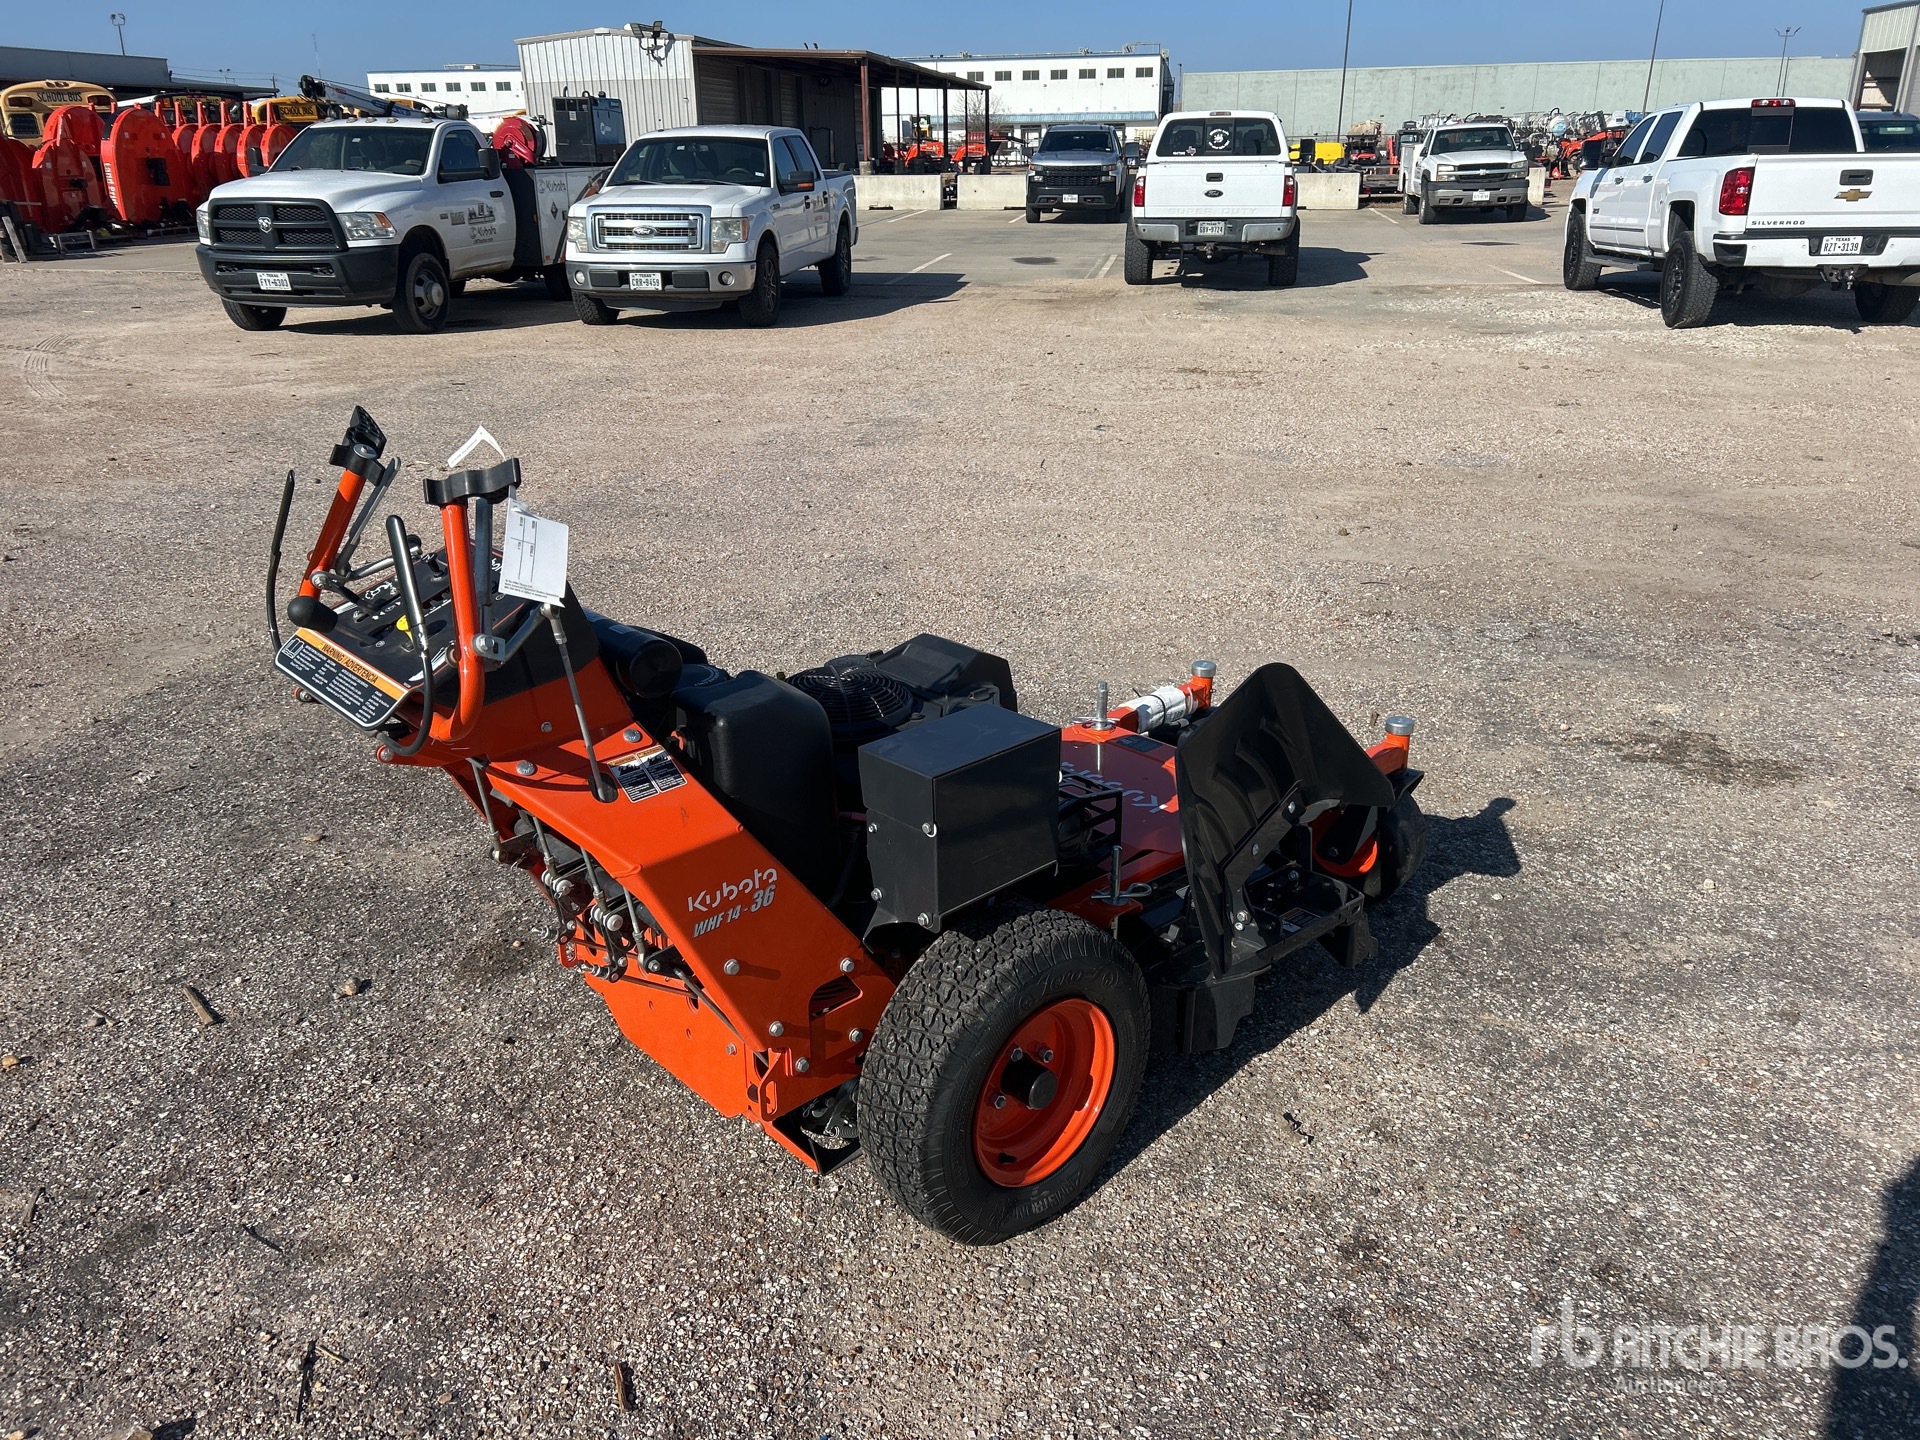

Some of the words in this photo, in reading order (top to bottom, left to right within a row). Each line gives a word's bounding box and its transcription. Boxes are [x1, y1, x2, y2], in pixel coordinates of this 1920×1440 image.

[37, 91, 66, 102] SCHOOL
[68, 92, 82, 102] BUS
[280, 106, 301, 116] SCHOOL
[302, 107, 314, 116] BUS
[103, 163, 115, 185] Land
[1168, 207, 1213, 216] SUPER
[1221, 207, 1258, 216] DUTY
[321, 643, 345, 665] WARNING
[344, 658, 379, 685] ADVERTENCIA
[687, 867, 778, 913] Kubota
[693, 911, 725, 938] WHF
